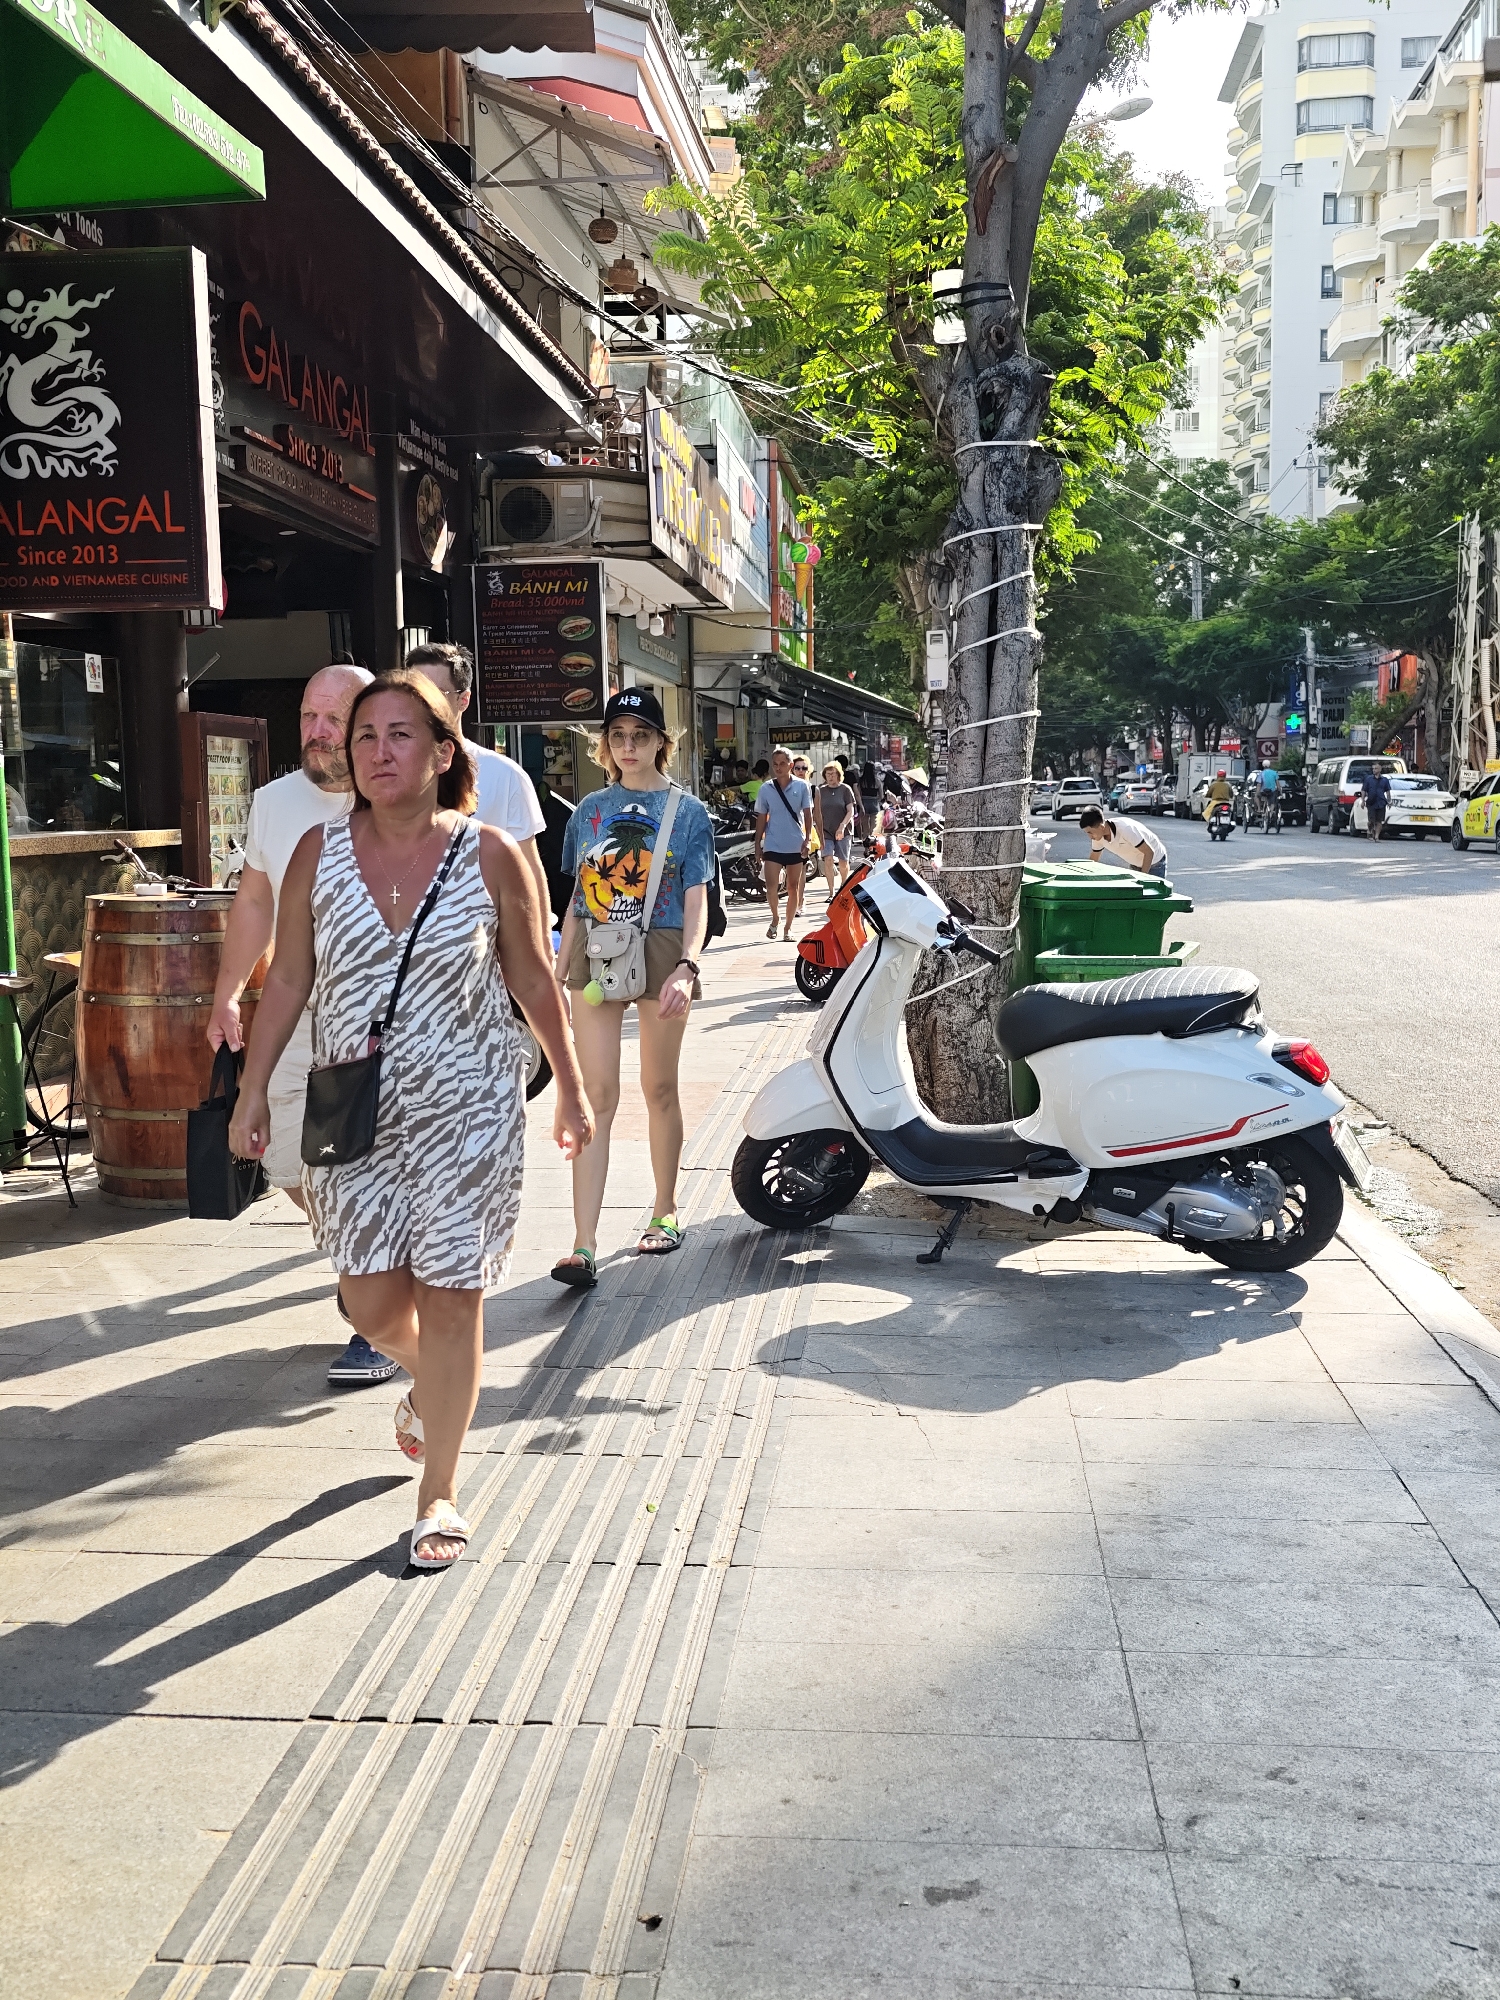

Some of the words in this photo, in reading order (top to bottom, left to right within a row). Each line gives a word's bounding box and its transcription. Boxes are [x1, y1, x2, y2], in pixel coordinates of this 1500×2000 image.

[76, 211, 103, 246] foods
[239, 300, 376, 457] GALANGAL
[288, 425, 317, 471] Since
[321, 445, 345, 484] 2013
[17, 545, 67, 566] Since
[72, 544, 119, 565] 2013
[32, 575, 60, 586] AND
[63, 573, 138, 587] VIETNAMESE
[141, 572, 189, 585] CUISINE
[521, 567, 576, 579] GALANGAL
[509, 579, 560, 595] BÁNH
[564, 577, 589, 593] MÌ
[490, 598, 525, 609] Bread:
[528, 596, 585, 608] 35.000vnd
[617, 694, 643, 707] 사장
[1321, 696, 1345, 705] HOTEL
[1322, 708, 1345, 722] PALM
[772, 733, 801, 742] МИР
[804, 730, 830, 740] ТУР
[239, 1162, 256, 1171] COSM
